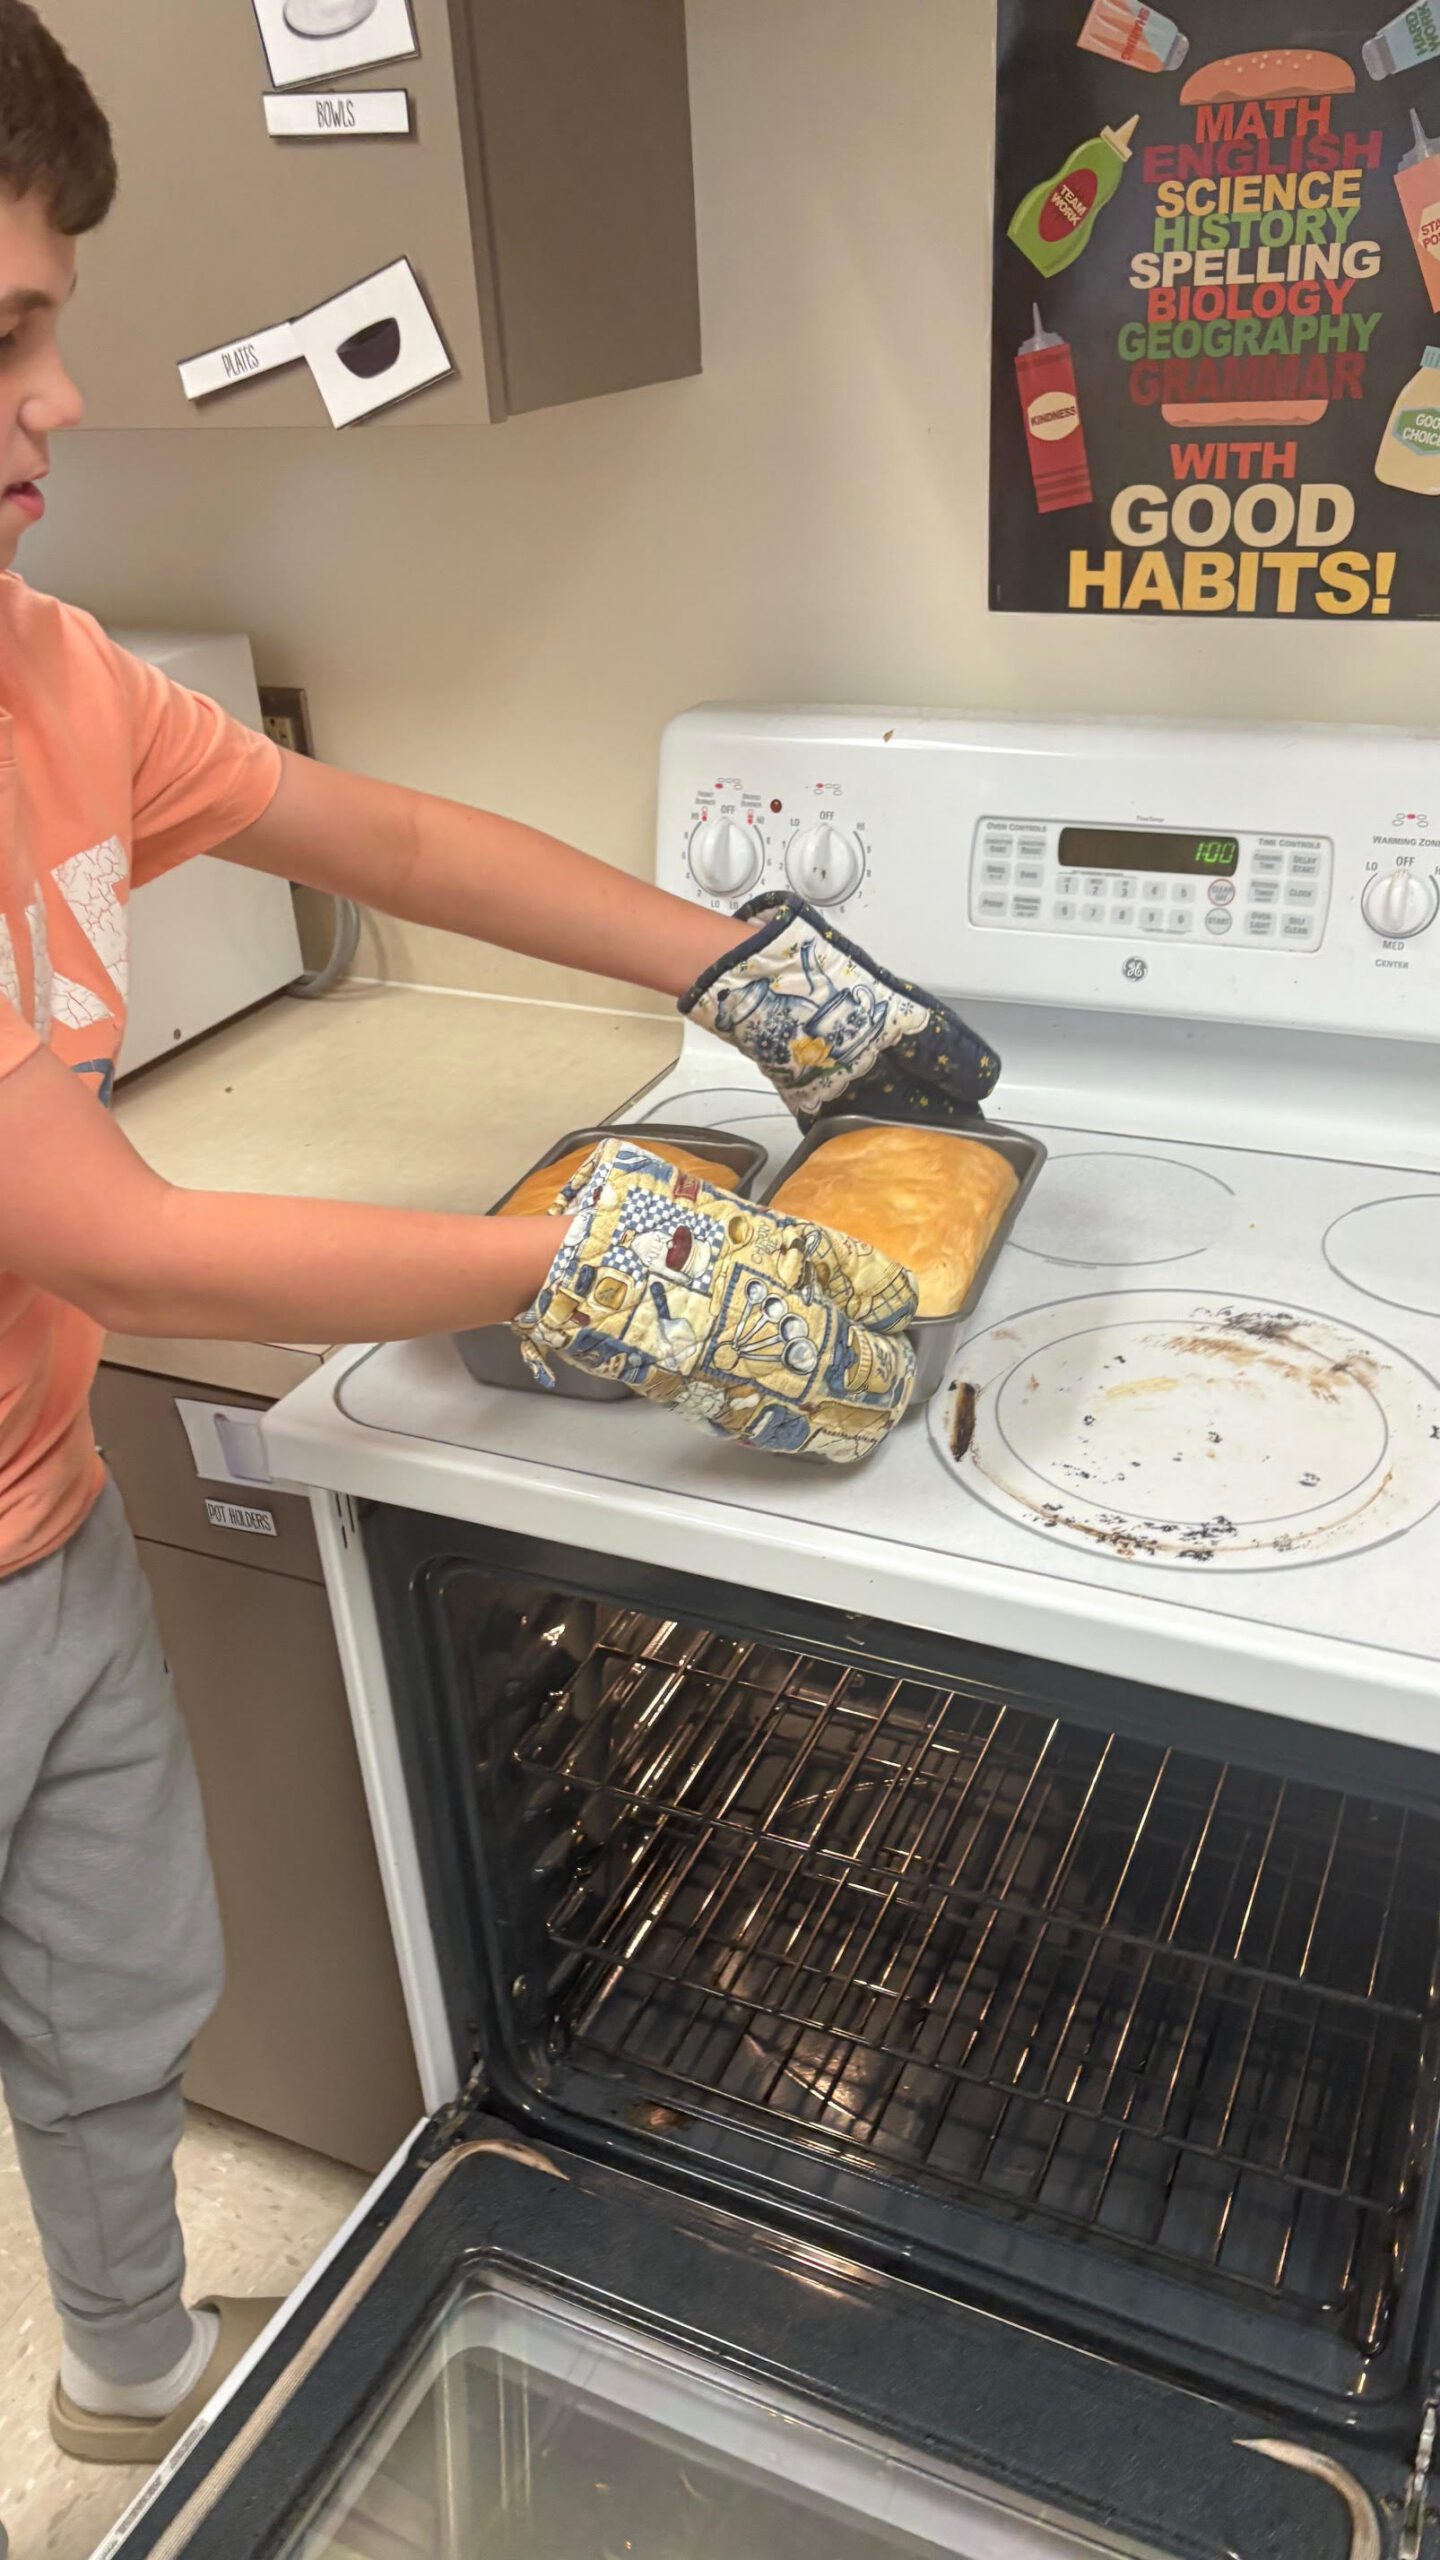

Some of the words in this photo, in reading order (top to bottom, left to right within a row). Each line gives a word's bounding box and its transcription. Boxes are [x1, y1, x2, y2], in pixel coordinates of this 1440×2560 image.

[1121, 7, 1150, 60] SHARING
[1405, 11, 1428, 56] HARD
[1417, 1, 1440, 52] WORK
[315, 99, 356, 128] BOWLS
[1195, 96, 1332, 143] MATH
[1143, 131, 1383, 184] ENGLISH
[1051, 192, 1081, 227] WORK
[1060, 184, 1087, 216] TEAM
[1155, 168, 1362, 218] SCIENCE
[1154, 207, 1360, 253] HISTORY
[1129, 241, 1381, 289] SPELLING
[1147, 279, 1357, 322] BIOLOGY
[1117, 312, 1382, 361] GEOGRAPHY
[221, 345, 260, 378] PLATES
[1128, 352, 1367, 407] GRAMMAR
[1031, 406, 1076, 427] KINDNESS
[1170, 441, 1297, 480] WITH
[1110, 483, 1355, 547] GOOD
[1068, 550, 1396, 615] HABITS!
[720, 804, 736, 815] OFF
[819, 810, 835, 821] OFF
[1373, 835, 1417, 847] WARMING
[1365, 860, 1379, 872] LO
[1396, 855, 1415, 868] OFF
[1375, 958, 1409, 969] CENTER
[1382, 940, 1405, 951] MED
[207, 1503, 227, 1524] POT
[227, 1507, 273, 1532] HOLDERS
